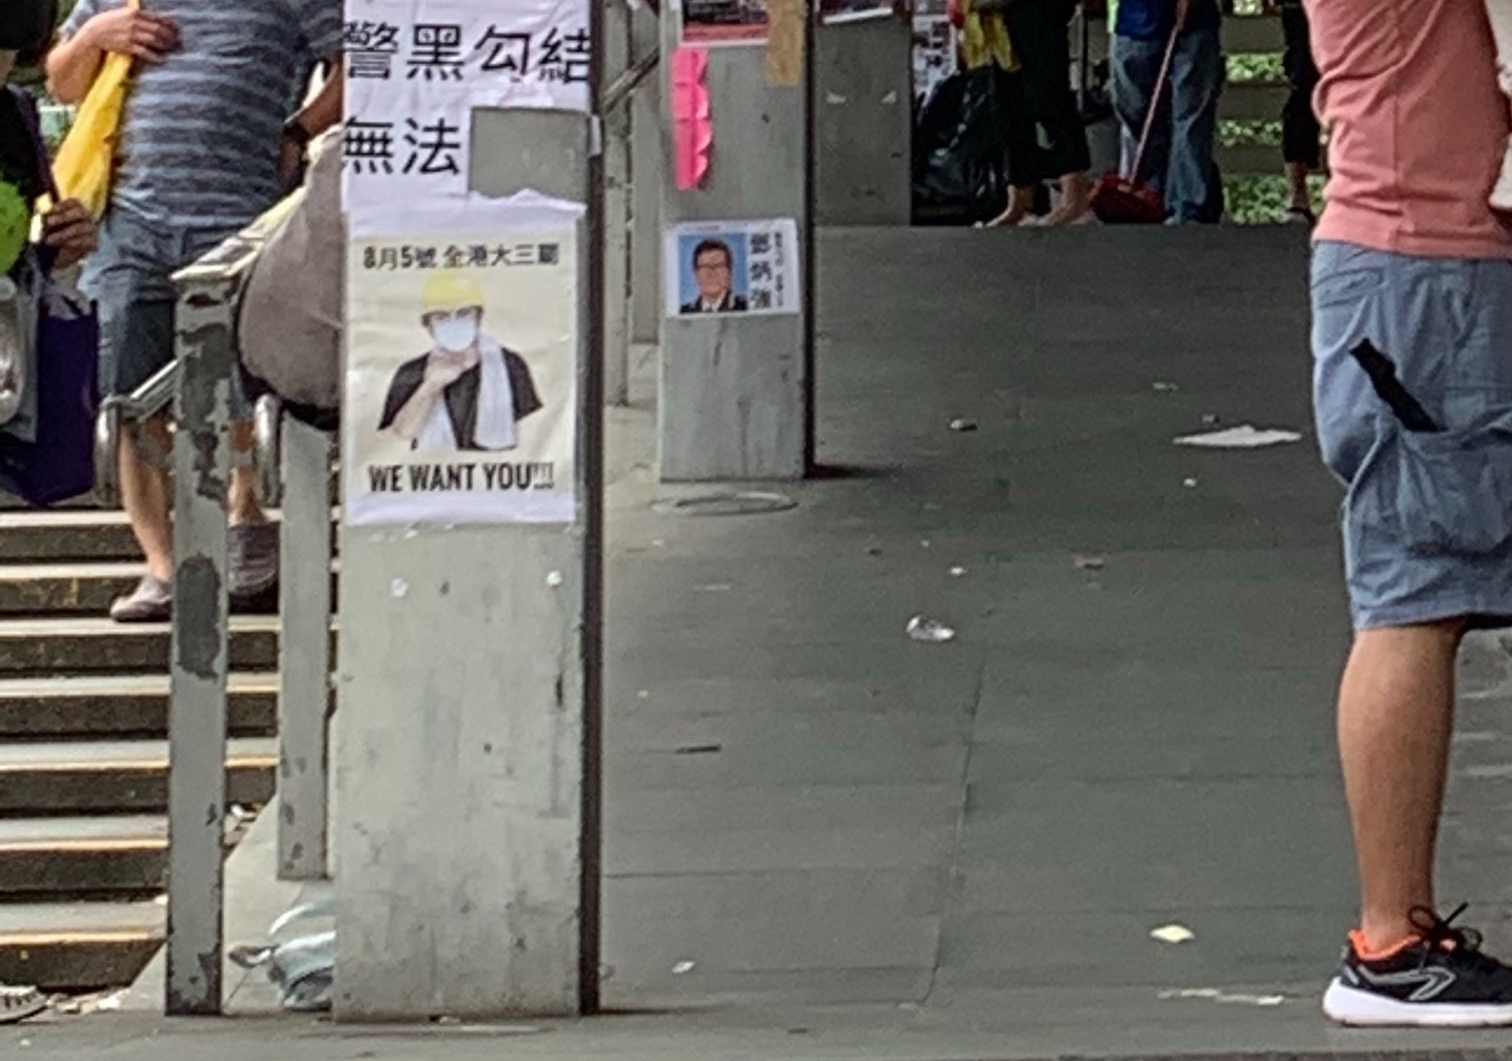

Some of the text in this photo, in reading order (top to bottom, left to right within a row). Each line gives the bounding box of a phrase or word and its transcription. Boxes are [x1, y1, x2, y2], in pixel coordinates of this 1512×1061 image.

[344, 20, 590, 84] 警黑勾結
[344, 115, 461, 176] 無法
[368, 463, 403, 492] WE
[409, 462, 476, 491] WANT
